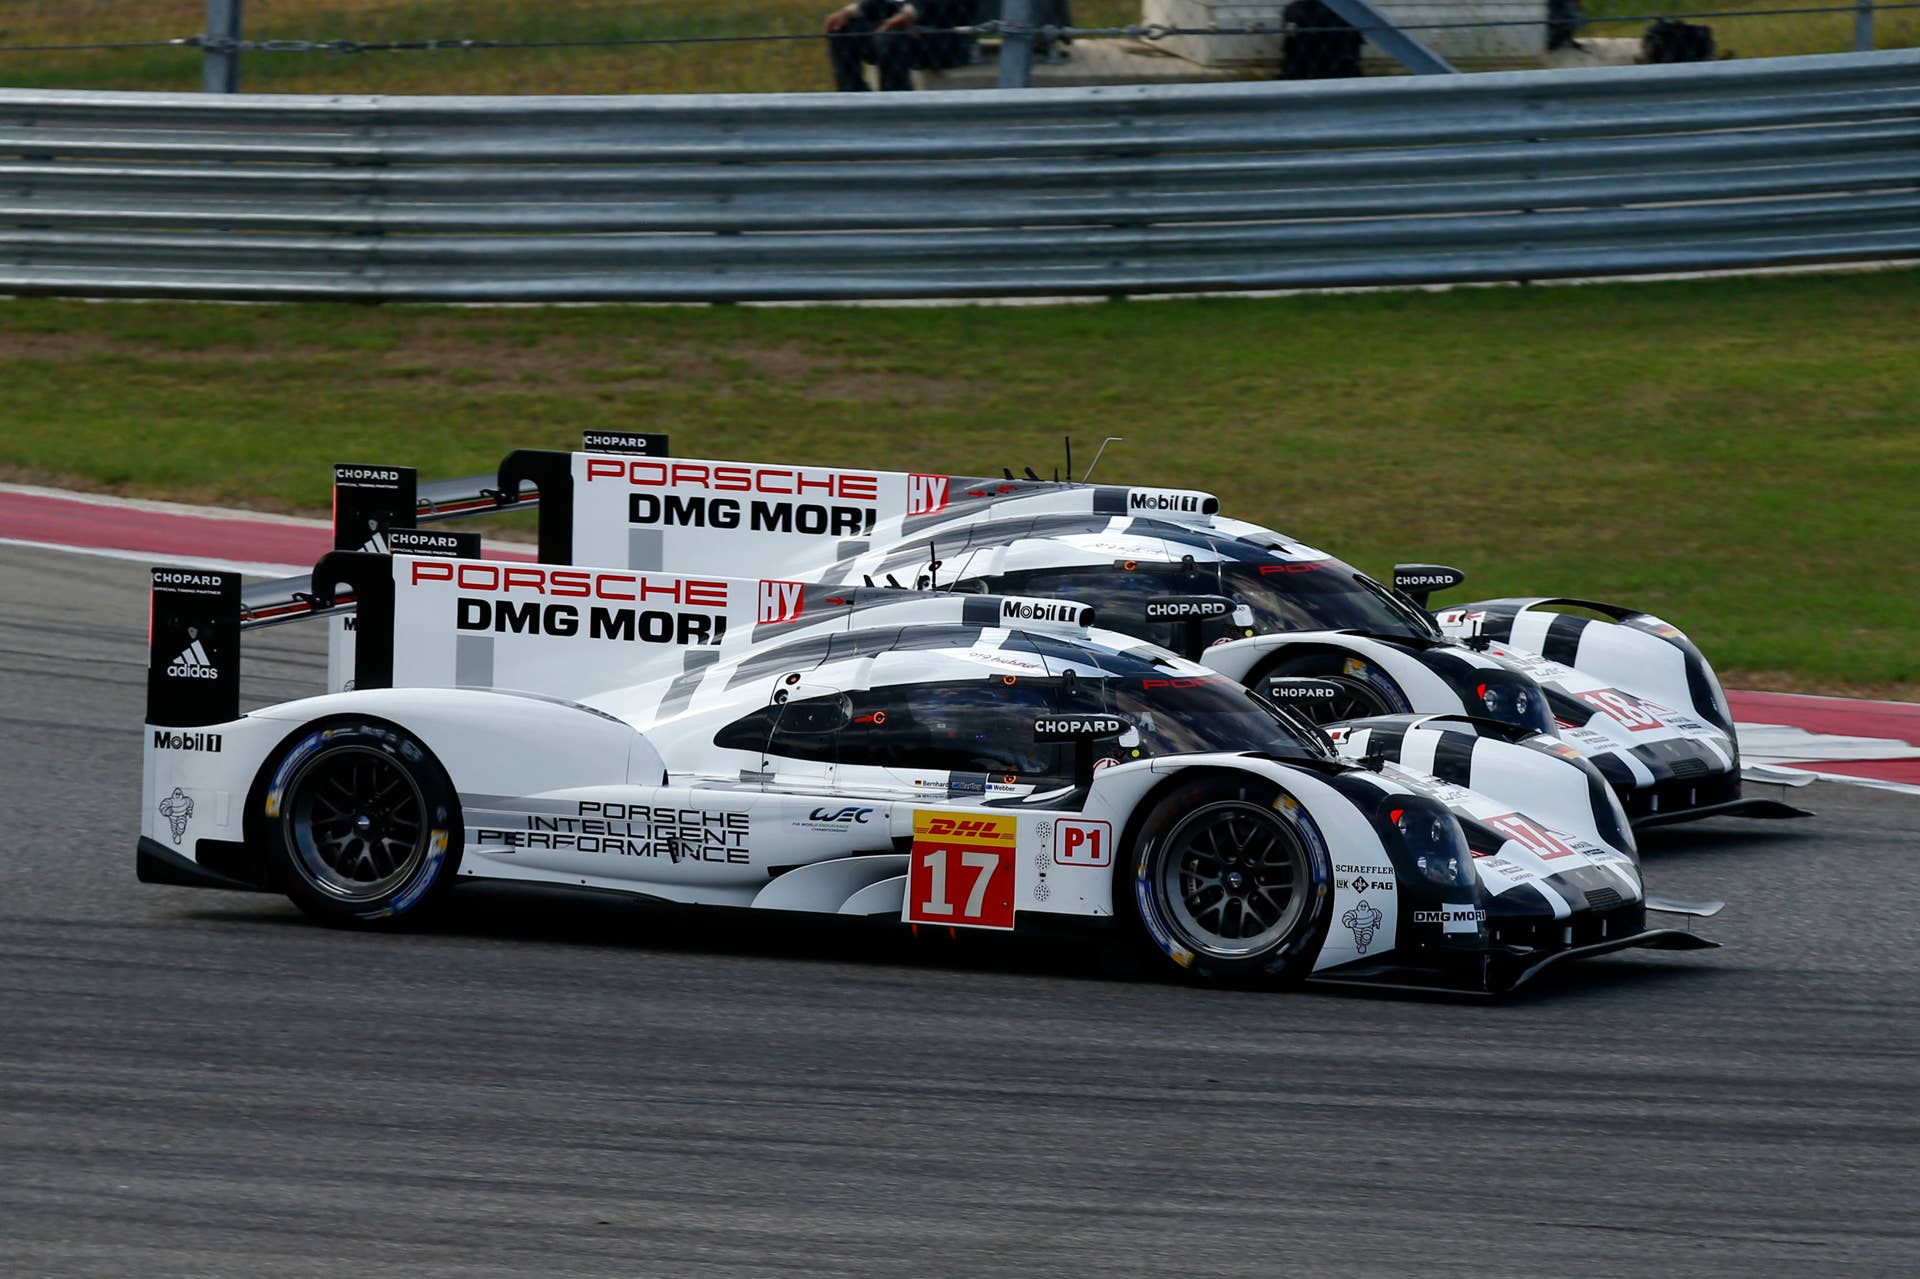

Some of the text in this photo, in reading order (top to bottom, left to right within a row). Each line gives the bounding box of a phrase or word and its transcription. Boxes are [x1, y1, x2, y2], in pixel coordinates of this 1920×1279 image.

[585, 435, 647, 447] CHOPARD
[336, 469, 399, 480] CHOPARD
[587, 459, 877, 500] PORSCHE
[909, 475, 946, 515] HY
[1131, 493, 1179, 512] Mobil
[628, 493, 877, 537] DMG MORI
[391, 533, 457, 547] CHOPARD
[153, 572, 222, 586] CHOPARD
[411, 561, 728, 608] PORSCHE
[1395, 575, 1454, 585] CHOPARD
[759, 581, 802, 624] HY
[1003, 601, 1057, 621] Mobil
[1147, 602, 1226, 616] CHOPARD
[457, 597, 727, 645] DMG MORI
[167, 663, 218, 679] adidas
[1272, 687, 1335, 698] CHOPARD
[1584, 690, 1655, 728] 18
[1034, 719, 1120, 733] CHOPARD
[154, 730, 204, 752] Mobil
[578, 800, 749, 829] PORSCHE
[809, 806, 874, 824] WEC
[527, 815, 749, 847] INTELLIGENT
[928, 818, 1001, 839] DHL
[1493, 815, 1563, 857] 17
[477, 829, 749, 864] PERFORMANCE
[1064, 827, 1100, 859] P1
[1335, 864, 1394, 875] SCHAEFFLER
[922, 850, 999, 918] 17
[1371, 881, 1393, 890] FAG
[1416, 909, 1486, 923] DMG MORI
